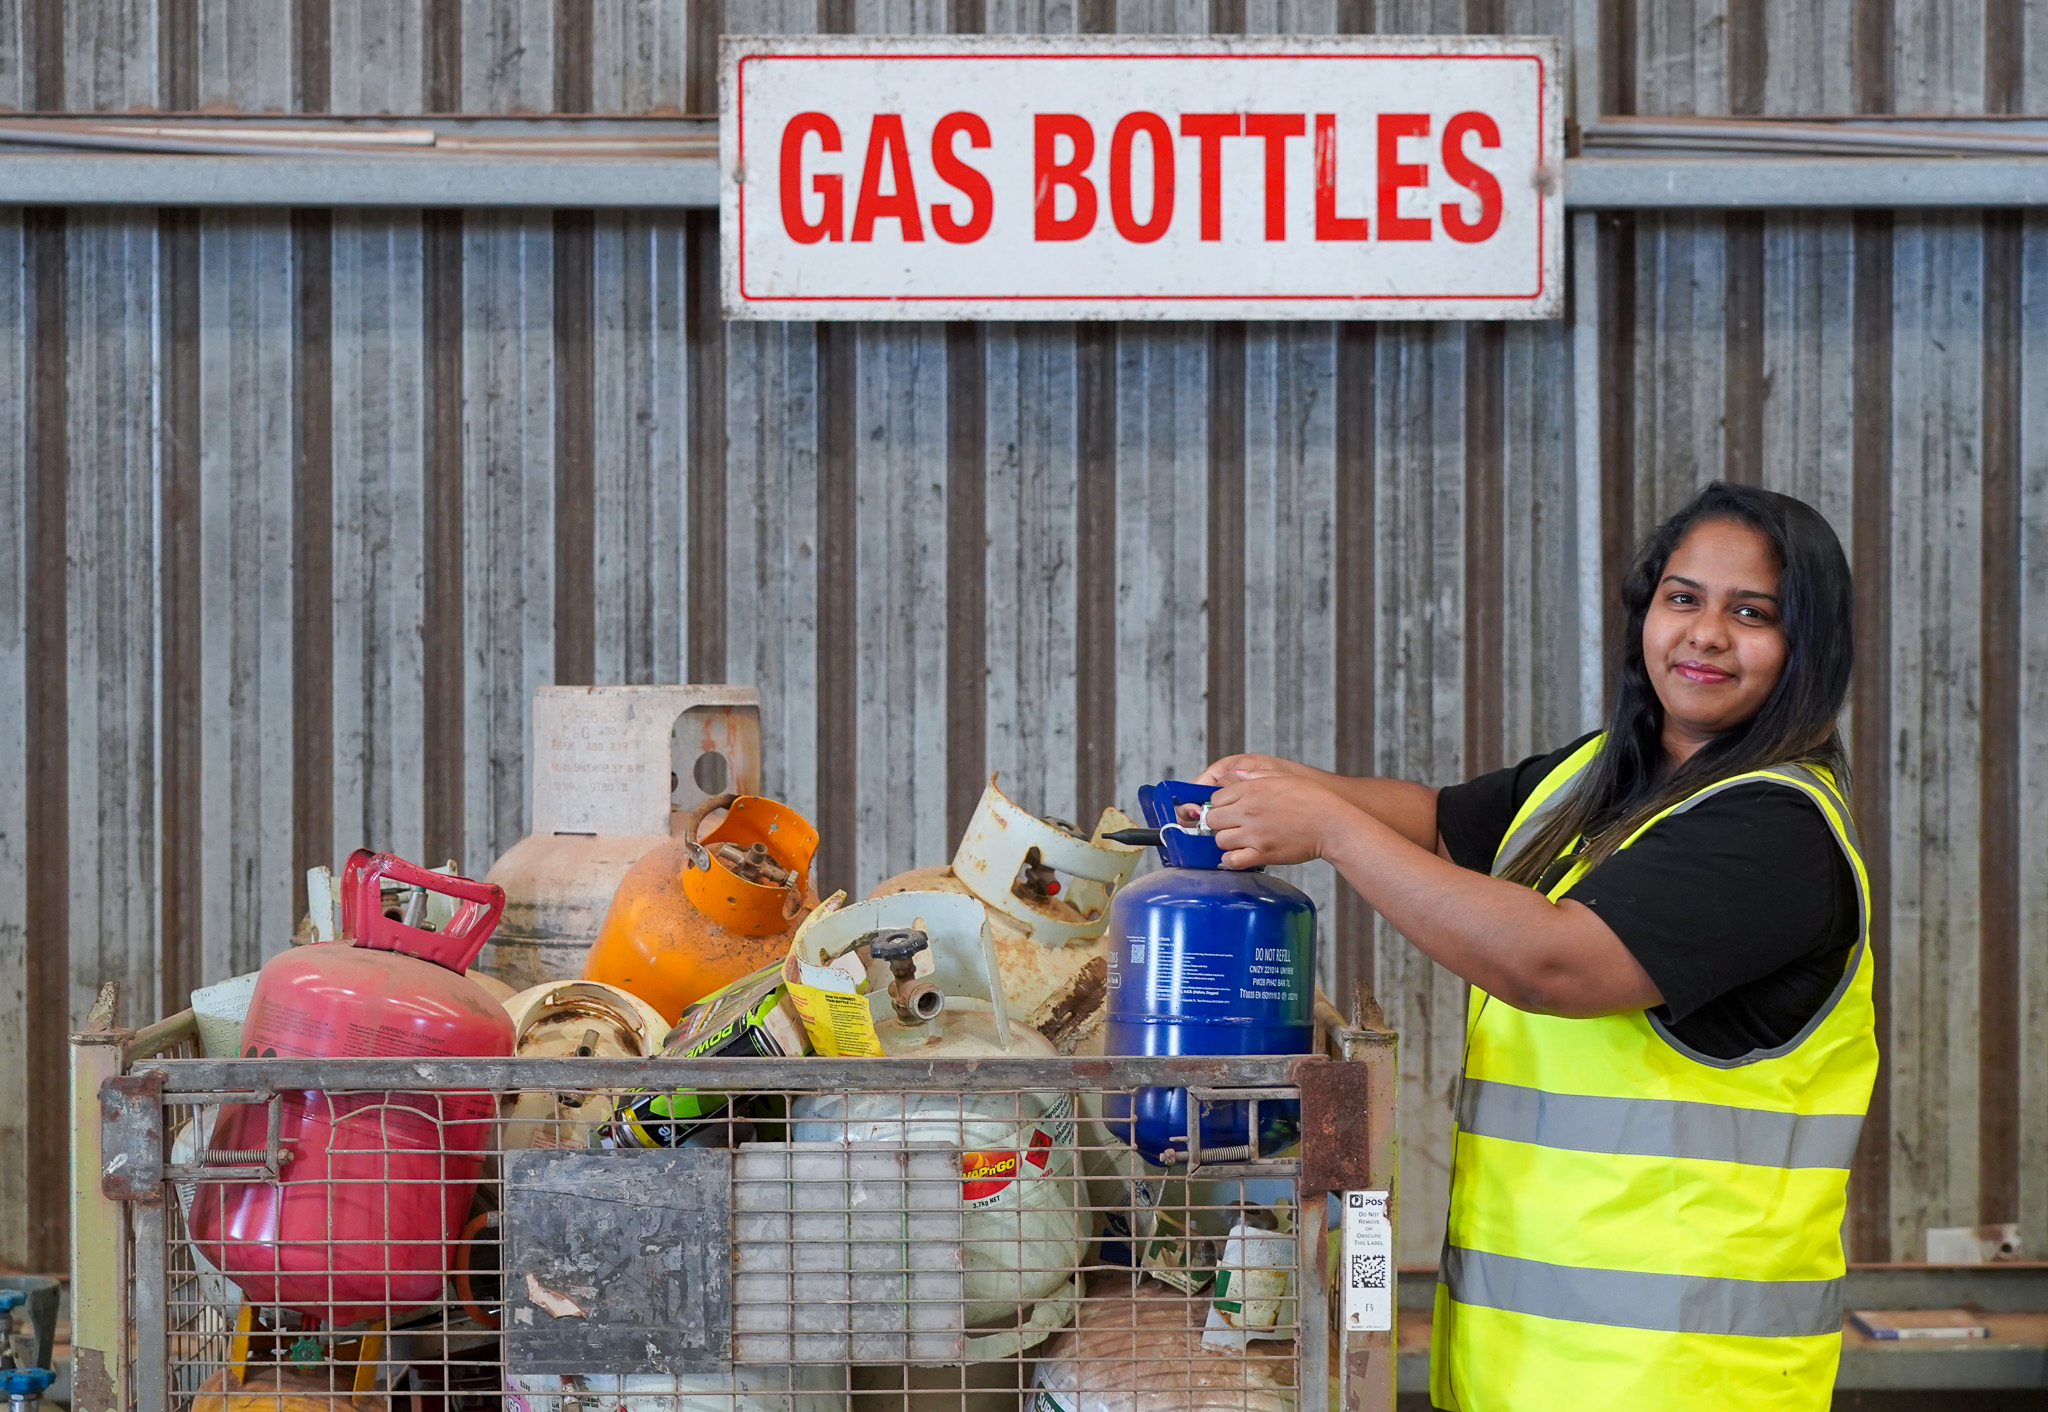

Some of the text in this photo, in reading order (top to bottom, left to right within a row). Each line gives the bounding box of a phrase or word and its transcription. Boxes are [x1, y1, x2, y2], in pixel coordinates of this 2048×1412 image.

[778, 110, 1504, 245] GAS BOTTLES
[1255, 947, 1291, 962] DO NOT REFILL
[972, 1194, 1000, 1209] 3.7kg NET
